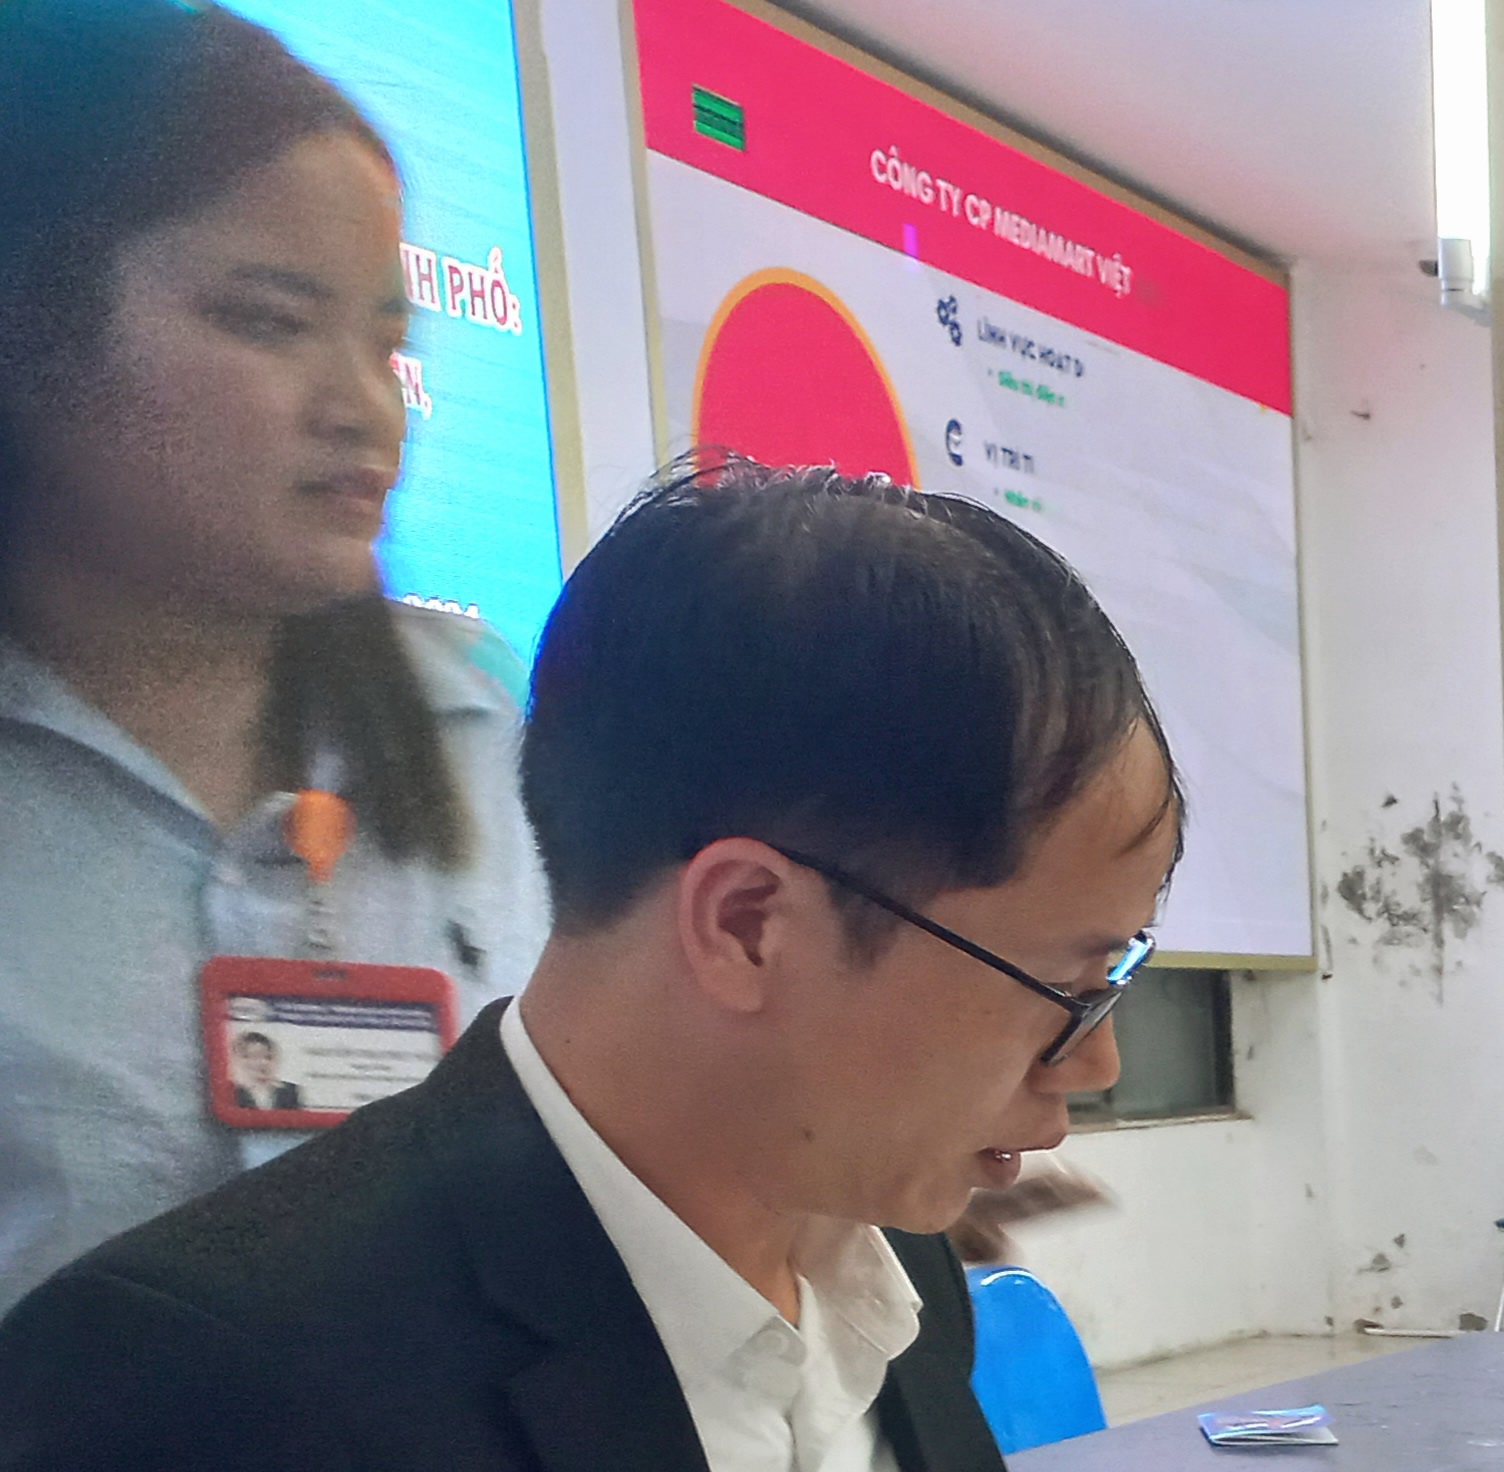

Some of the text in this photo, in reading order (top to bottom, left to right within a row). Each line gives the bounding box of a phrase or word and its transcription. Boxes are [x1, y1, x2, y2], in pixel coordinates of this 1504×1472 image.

[870, 145, 1132, 298] CÔNG TY CP MEDIAMART VIỆT
